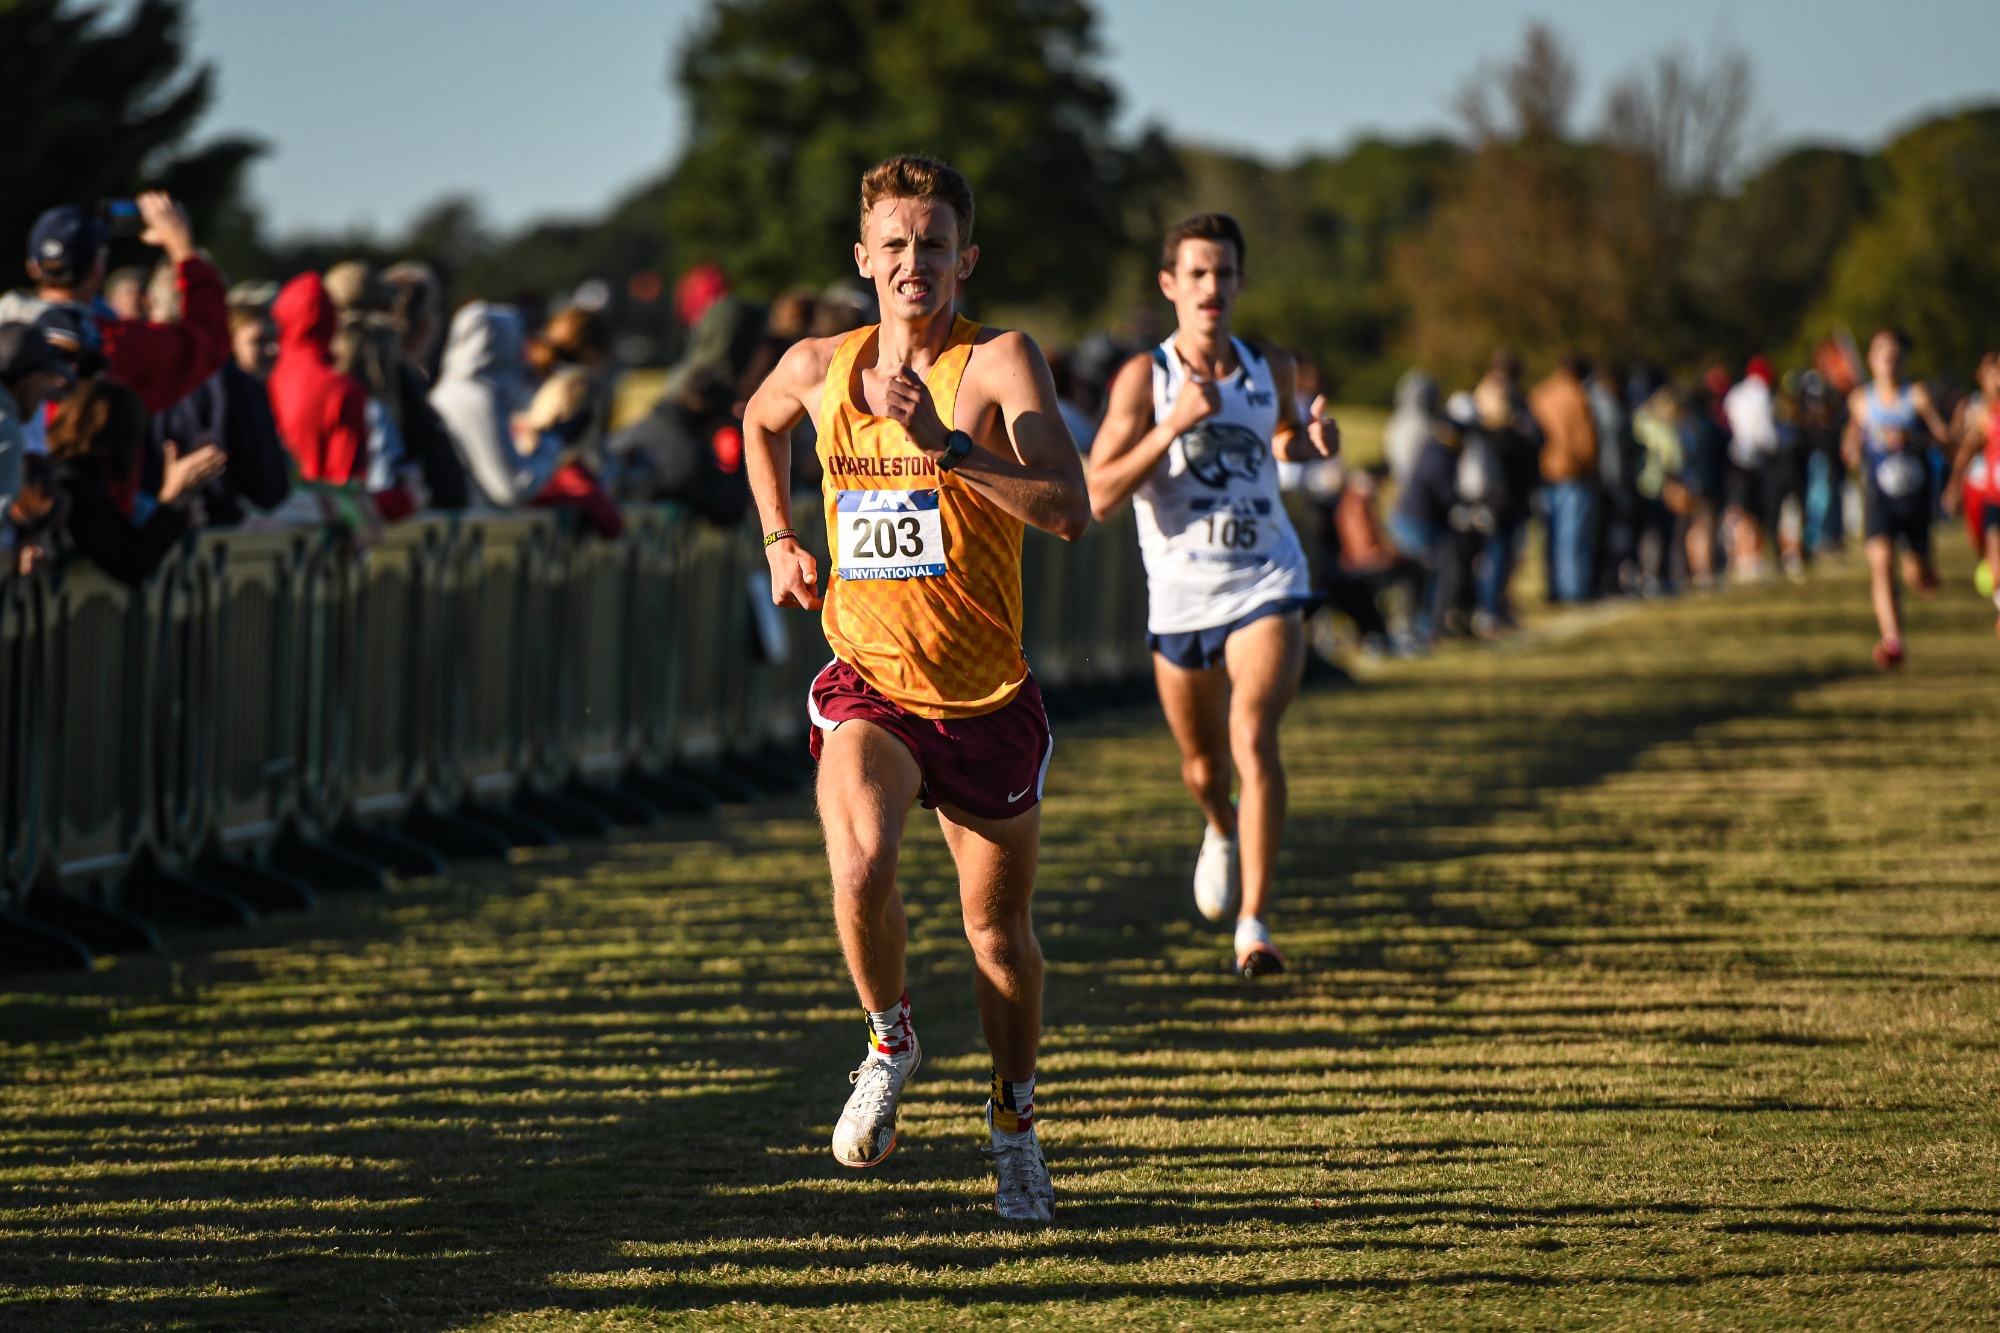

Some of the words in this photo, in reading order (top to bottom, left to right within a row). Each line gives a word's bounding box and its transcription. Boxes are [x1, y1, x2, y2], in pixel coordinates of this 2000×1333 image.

[828, 455, 937, 477] CHARLESTON
[852, 516, 924, 559] 203
[1204, 516, 1258, 550] 105
[849, 565, 934, 580] INVITATIONAL
